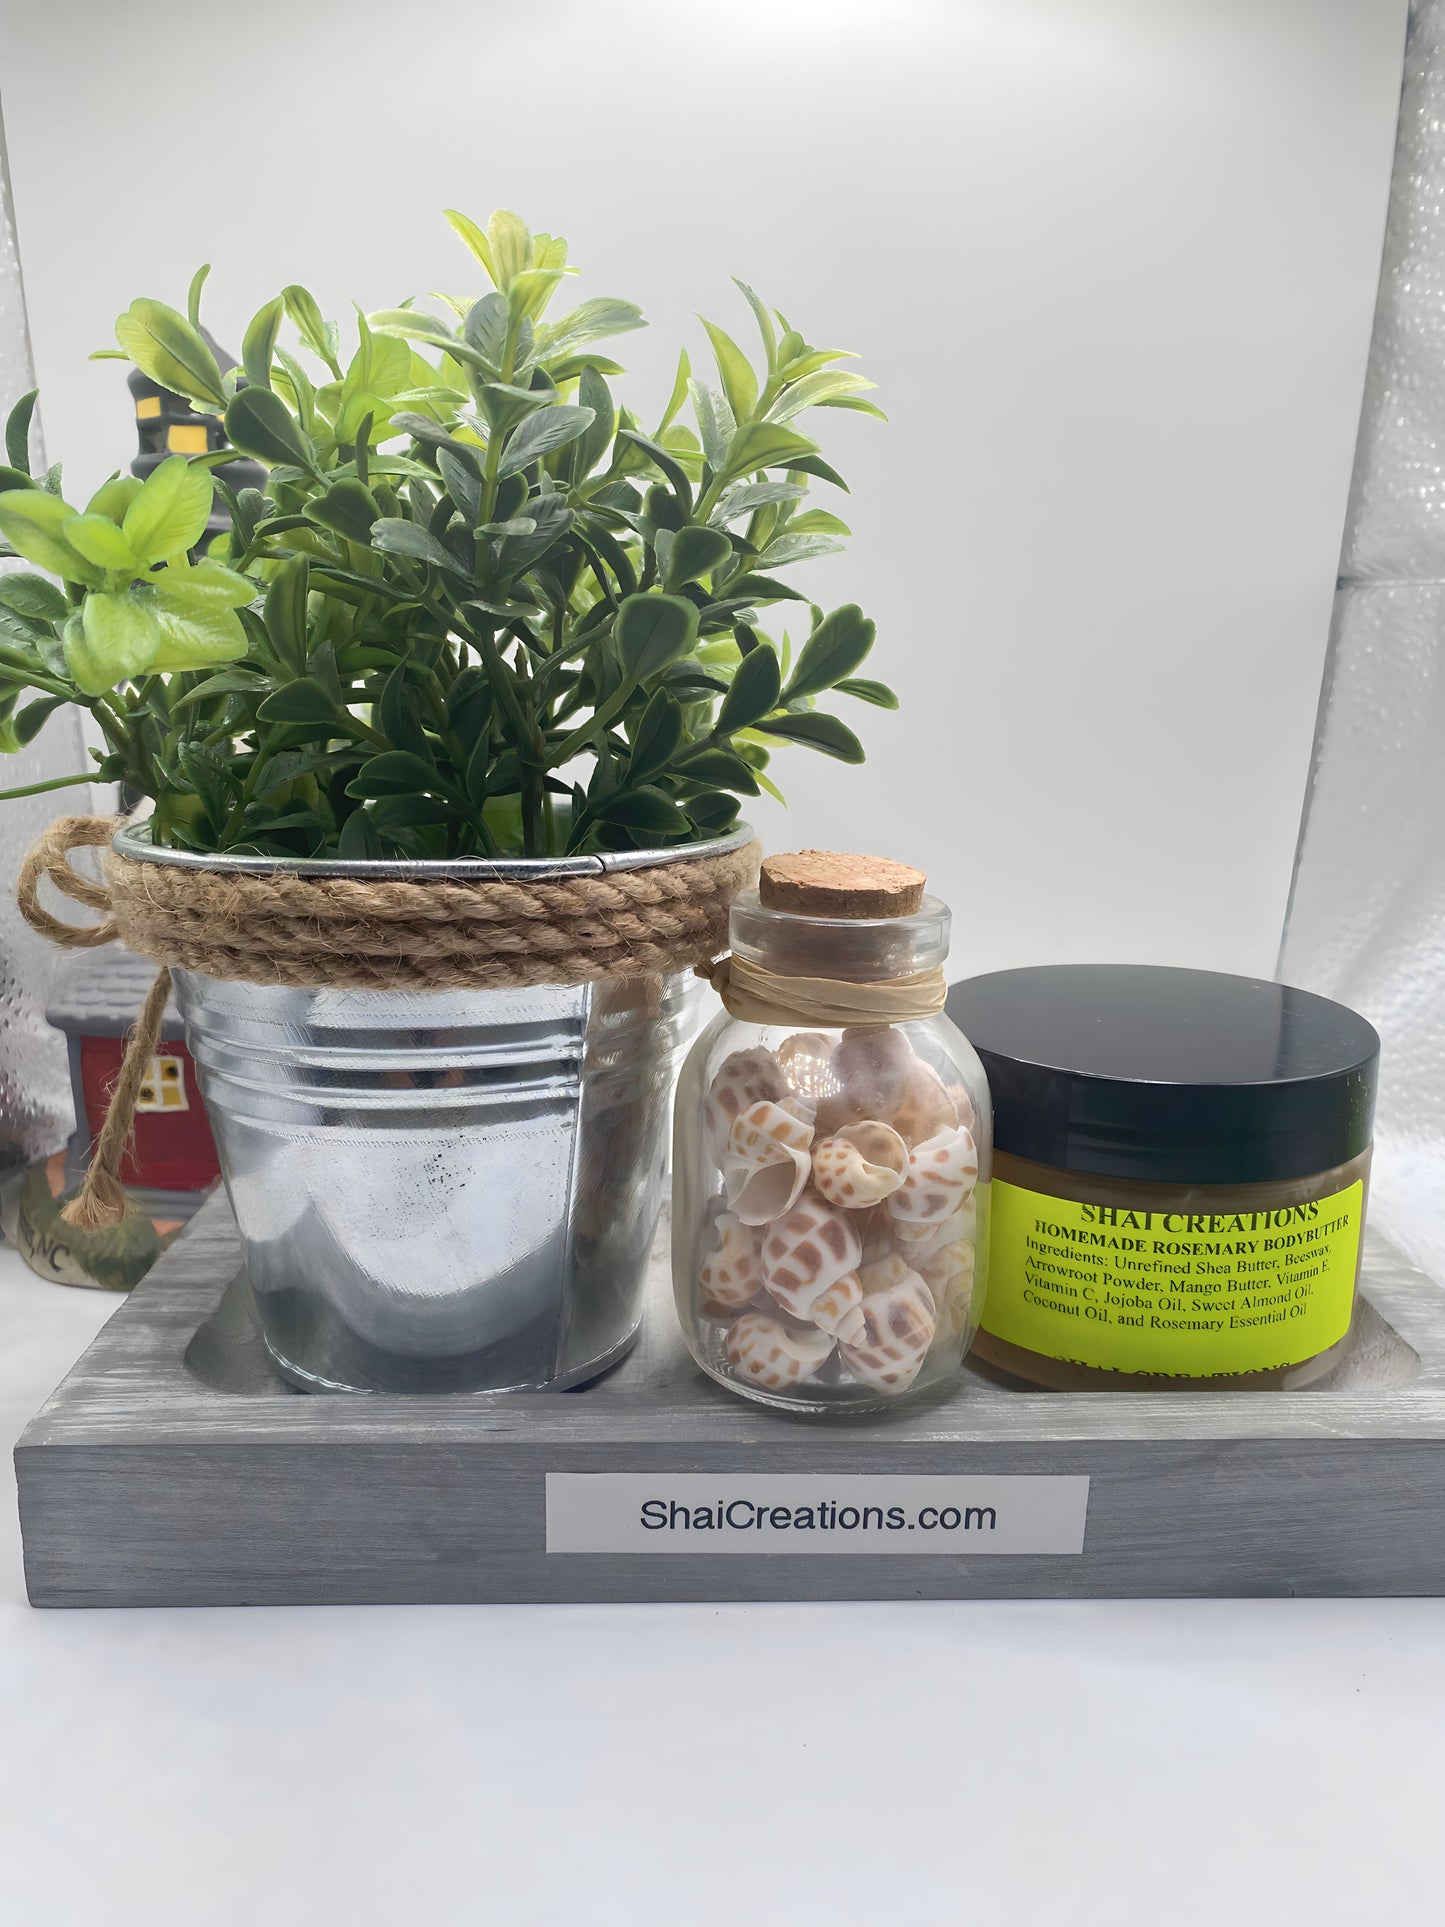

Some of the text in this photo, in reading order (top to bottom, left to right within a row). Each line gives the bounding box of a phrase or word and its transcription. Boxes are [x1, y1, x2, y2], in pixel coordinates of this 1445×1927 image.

[1034, 1214, 1350, 1256] HOMEMADE ROSEMARY BODYBUTTER
[1081, 1200, 1319, 1234] SHAI CREATIONS
[1025, 1254, 1099, 1284] Arrowroot
[1103, 1272, 1164, 1293] Powder,
[1169, 1279, 1222, 1297] Mango
[1227, 1279, 1272, 1293] Butter,
[1276, 1265, 1320, 1286] Vitamin
[1026, 1235, 1109, 1267] Ingredients:
[1115, 1255, 1191, 1275] Unrefined
[1195, 1261, 1232, 1275] Shea
[1236, 1258, 1281, 1274] Butter,
[1023, 1288, 1308, 1333] Coconut Oil, and Rosemary Essential Oil
[1024, 1270, 1079, 1298] Vitamin
[1082, 1287, 1099, 1304] C,
[1103, 1291, 1153, 1310] Jojoba
[1158, 1297, 1187, 1313] Oil,
[1191, 1298, 1236, 1312] Sweet
[1240, 1289, 1292, 1310] Almond
[639, 1499, 998, 1531] ShaiCreations.com
